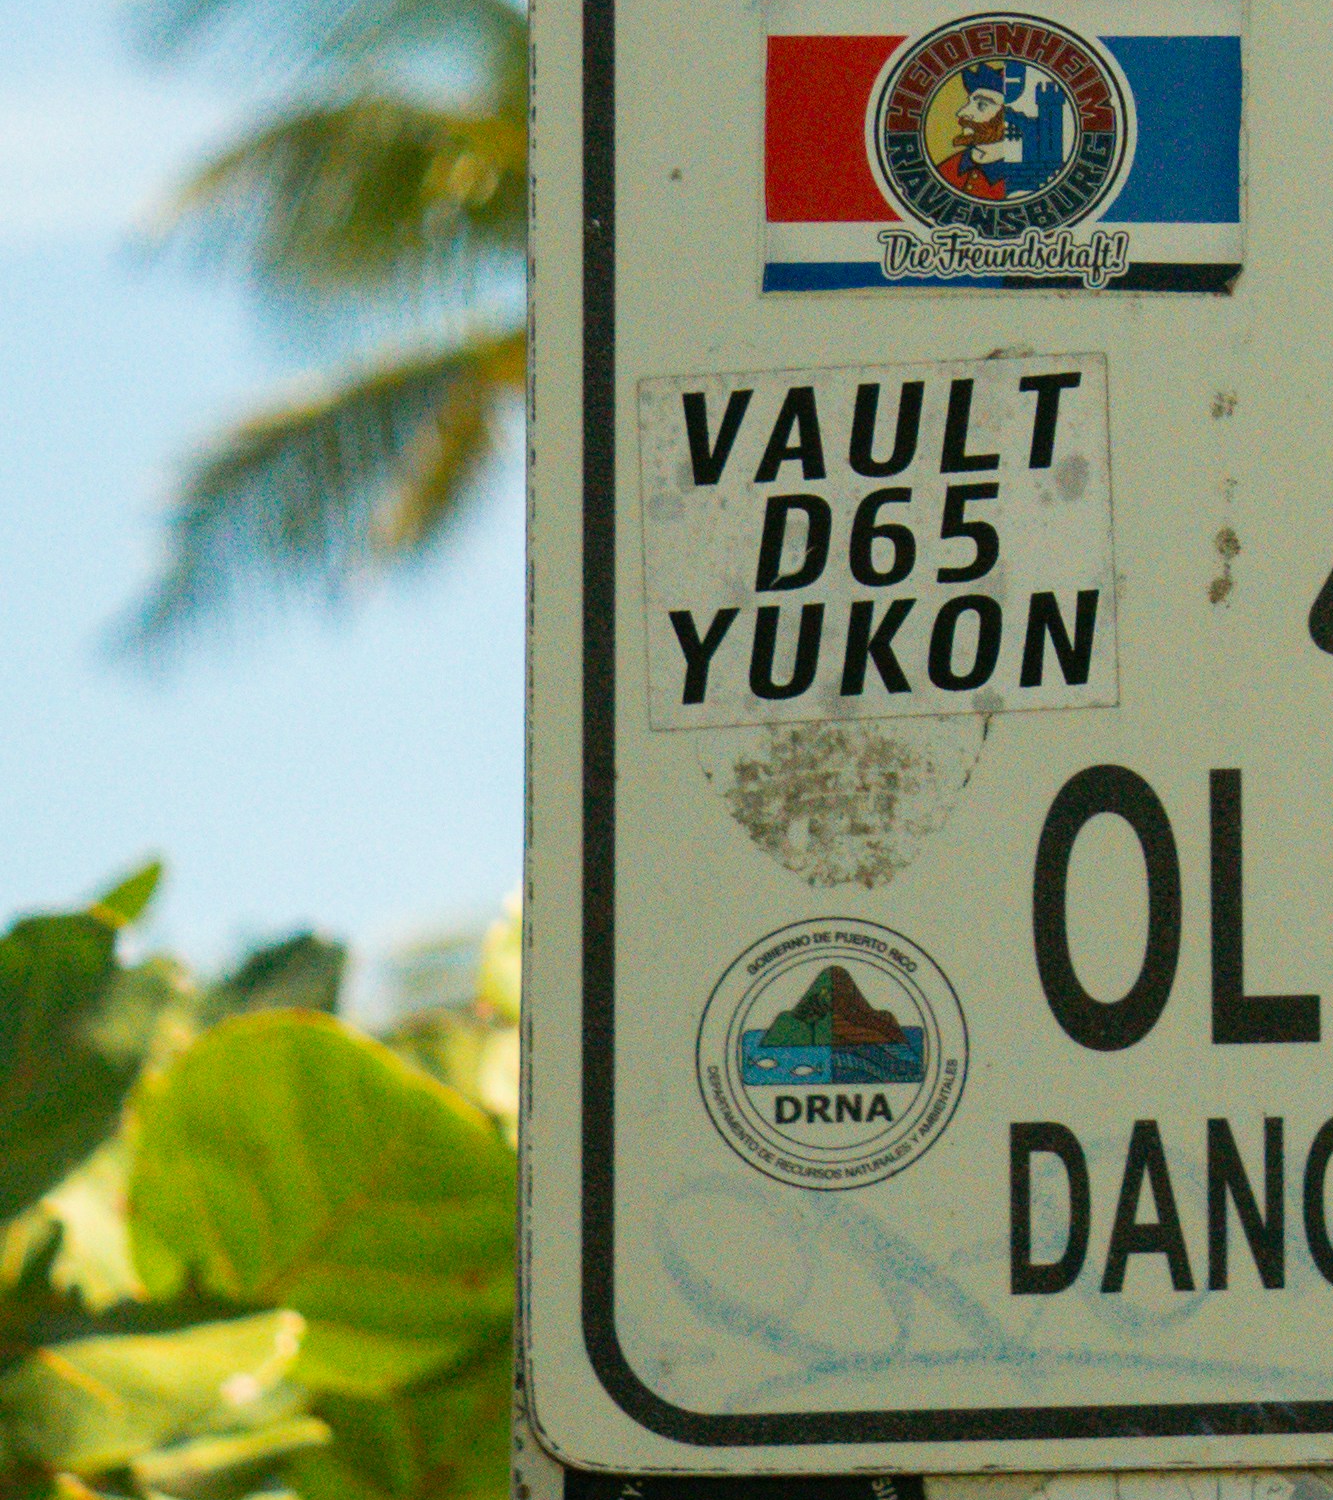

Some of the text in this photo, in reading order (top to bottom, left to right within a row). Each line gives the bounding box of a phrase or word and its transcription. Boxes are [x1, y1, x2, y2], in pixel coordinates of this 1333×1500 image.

[886, 21, 1118, 132] HEIDENHEIM
[886, 131, 1118, 240] RAVENSBURG
[882, 232, 1127, 283] Die Freundschaft!
[679, 370, 1081, 487] VAULT
[753, 482, 1001, 594] D65
[667, 588, 1101, 707] YUKON
[747, 931, 918, 976] GOBIERNO DE PUERTO RICO
[774, 1093, 893, 1124] DRNA
